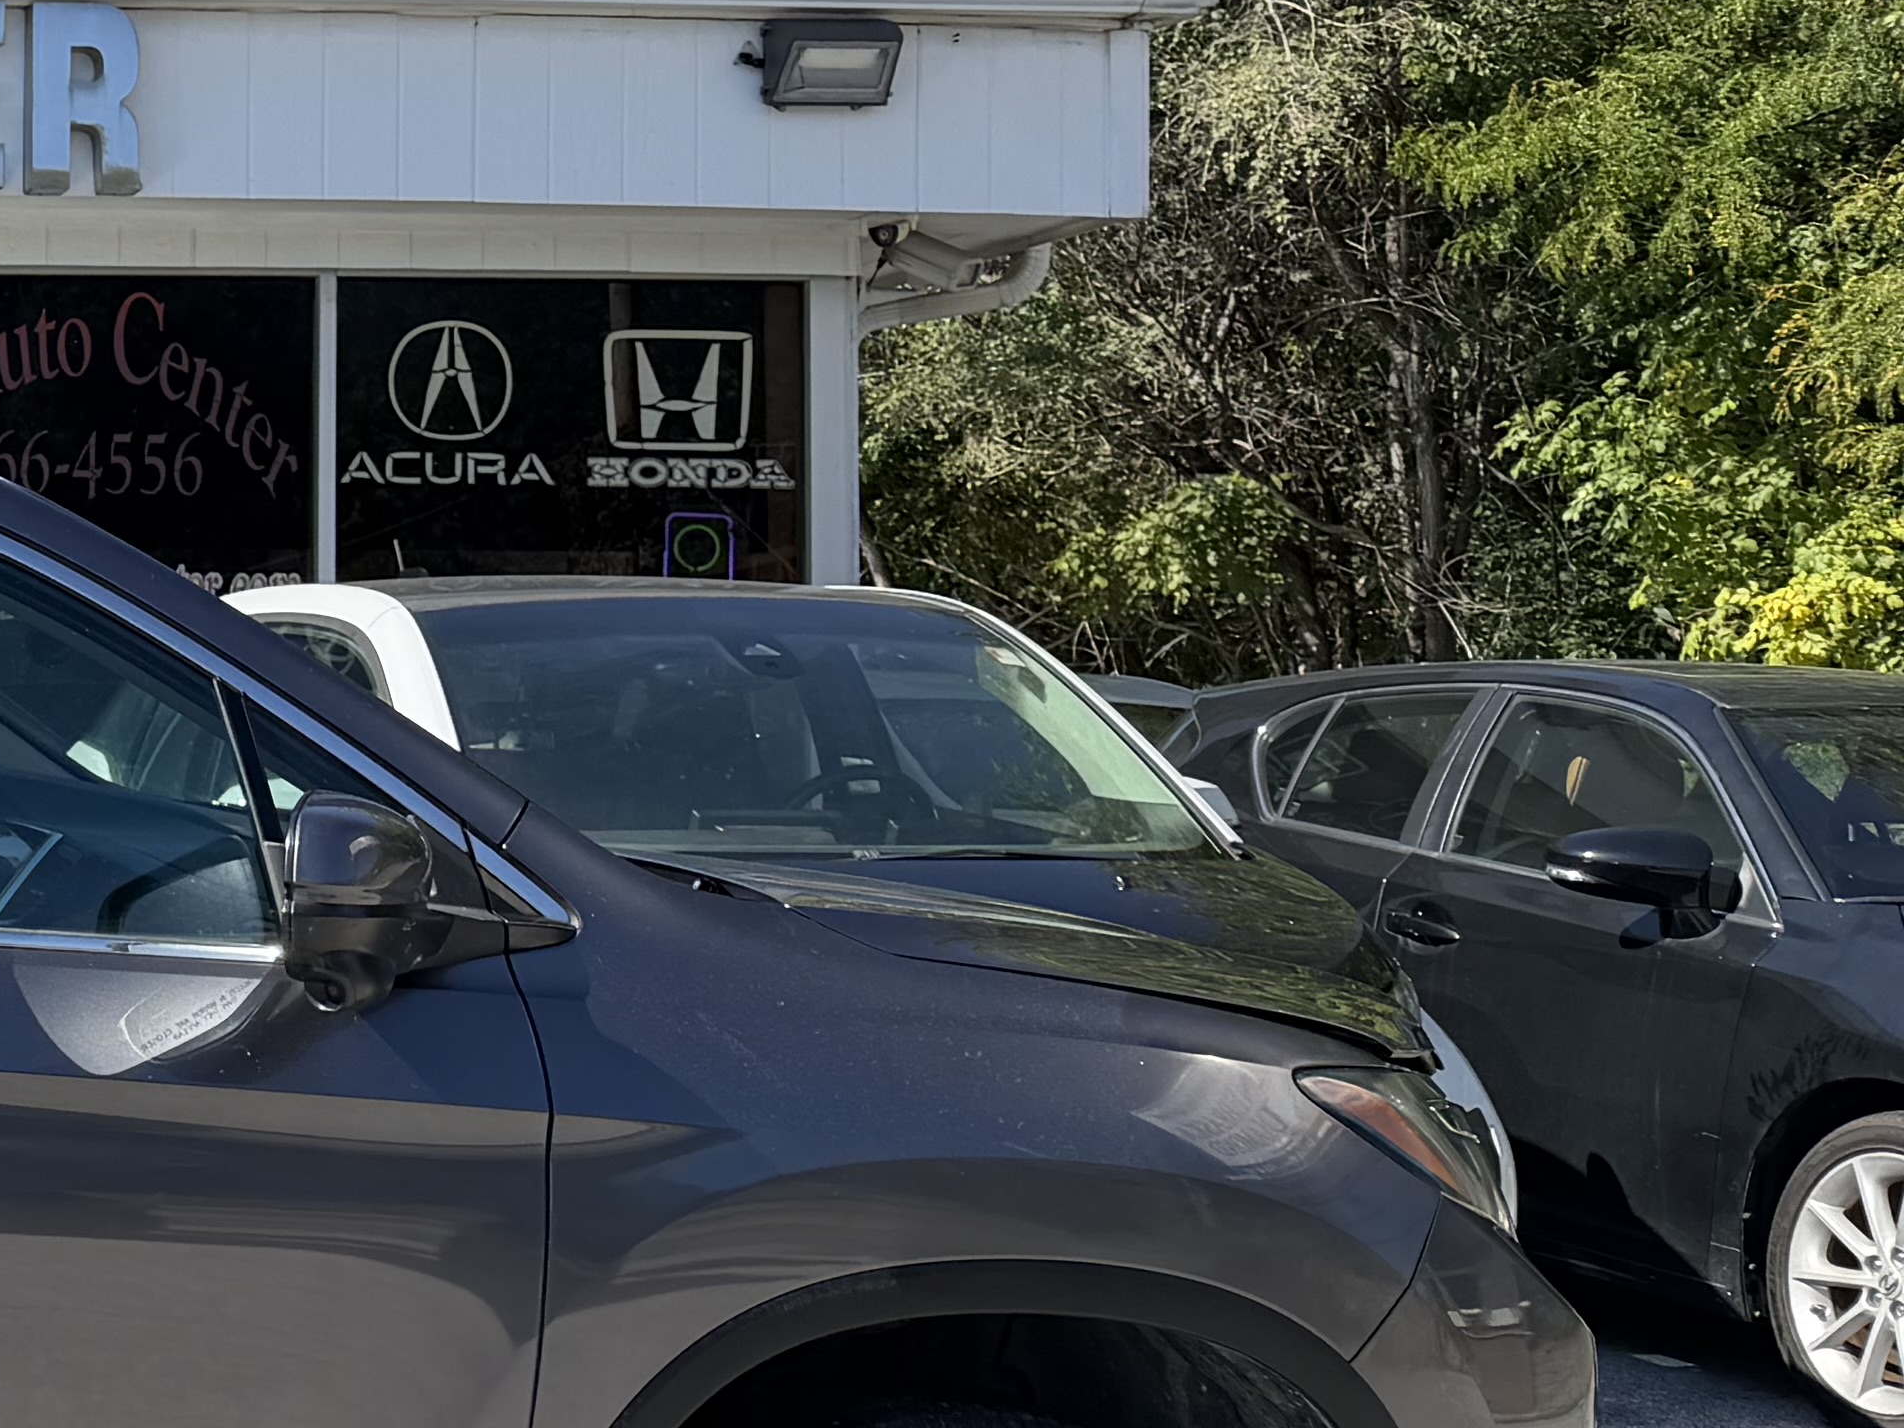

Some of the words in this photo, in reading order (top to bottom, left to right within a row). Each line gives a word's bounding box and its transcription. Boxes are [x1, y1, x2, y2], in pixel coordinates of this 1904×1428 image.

[112, 291, 299, 500] Center
[340, 450, 555, 487] ACURA
[586, 456, 796, 491] HONDA
